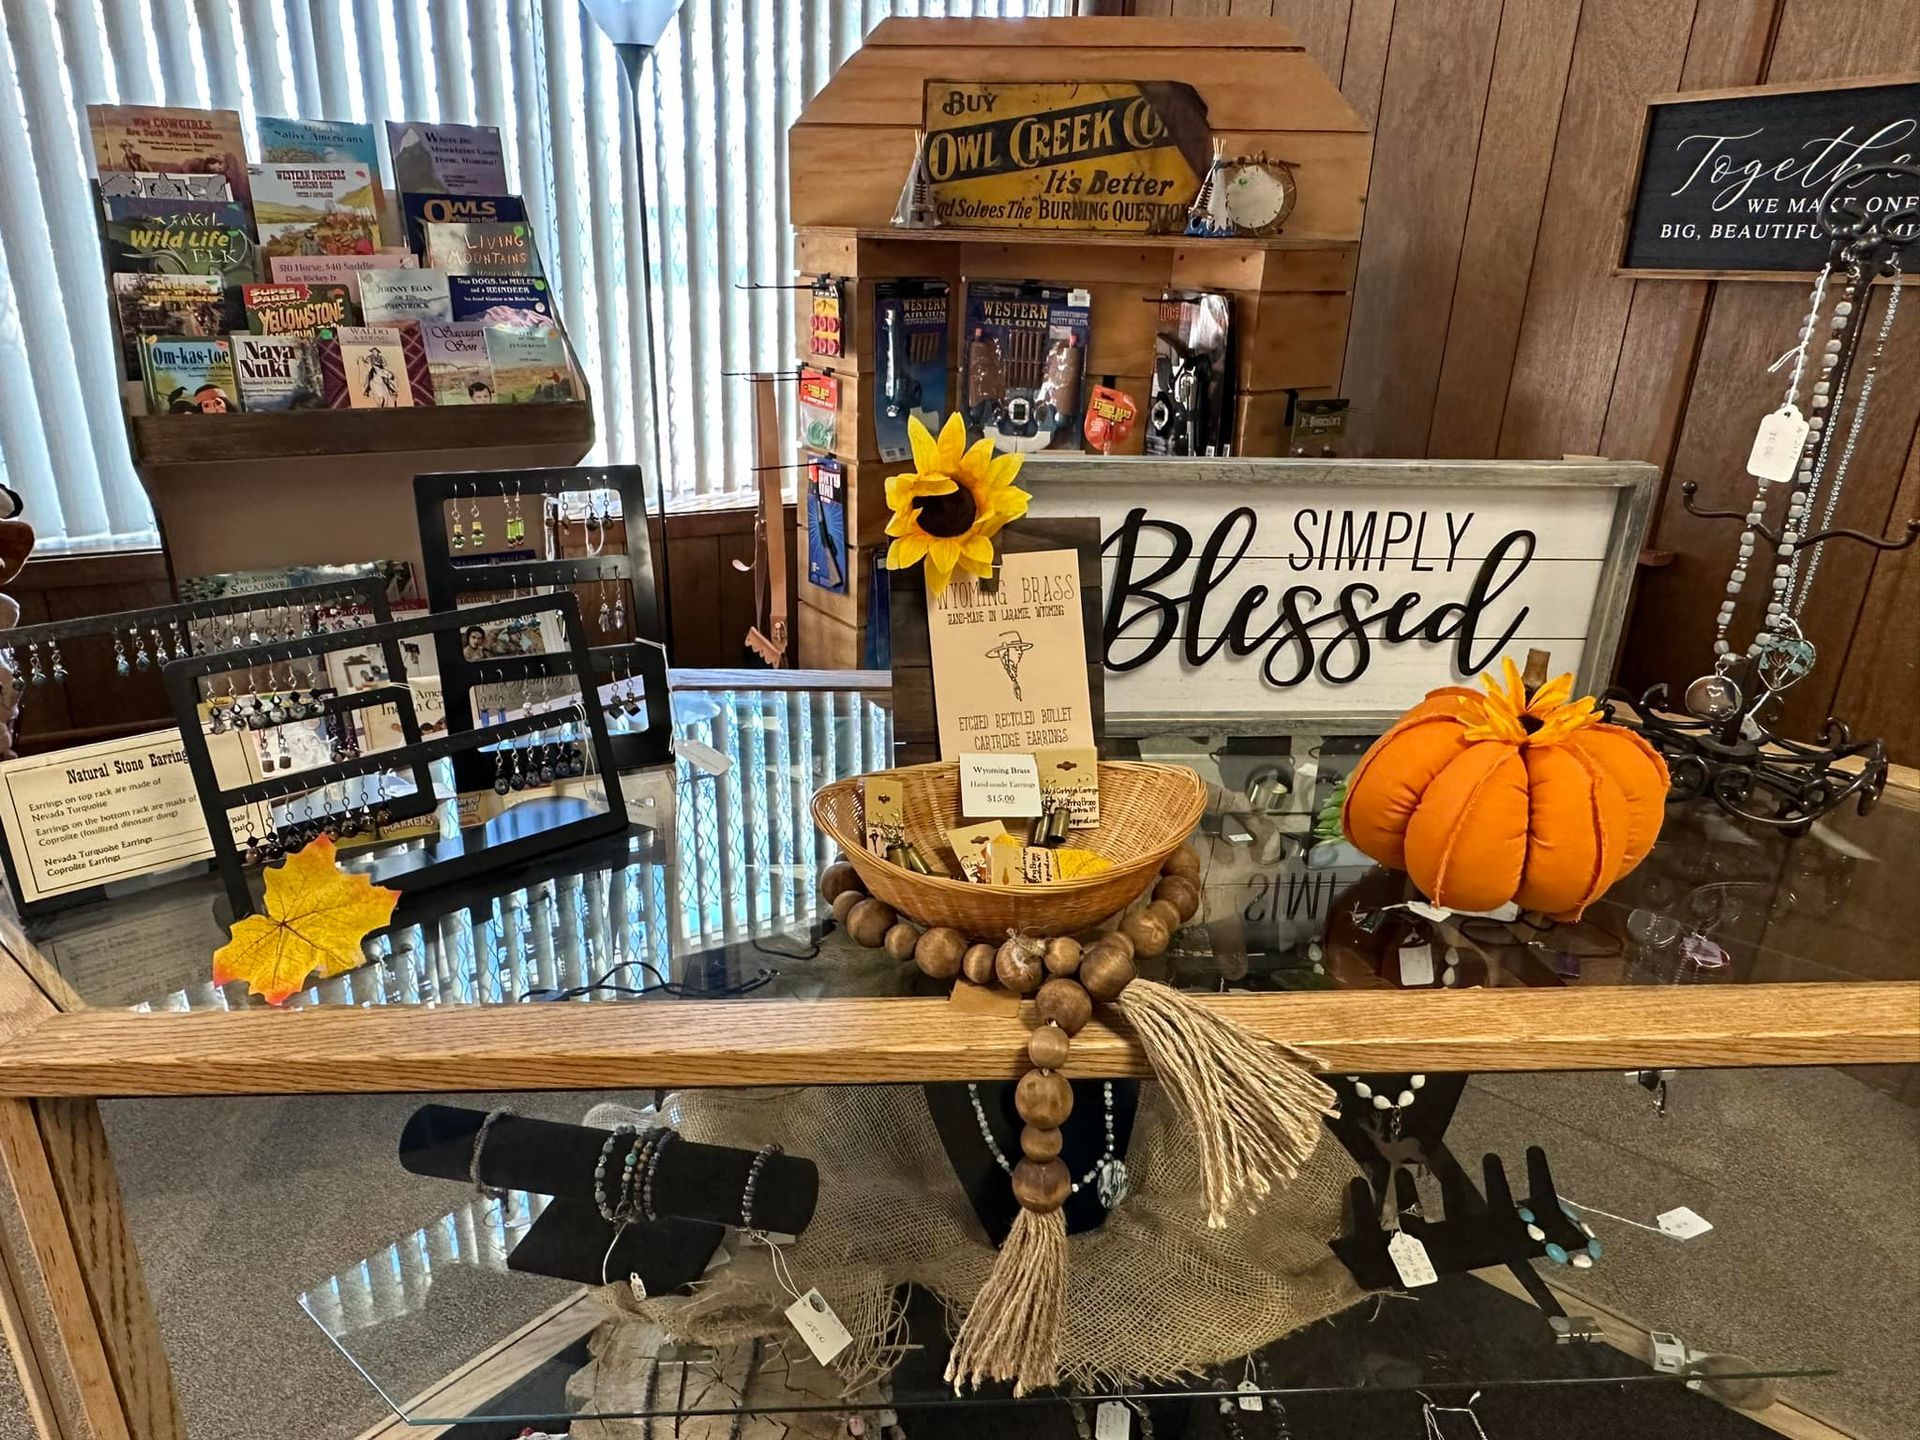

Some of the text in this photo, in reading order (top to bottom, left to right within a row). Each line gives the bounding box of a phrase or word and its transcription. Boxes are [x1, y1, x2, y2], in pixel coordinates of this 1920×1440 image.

[942, 91, 997, 116] BUY
[154, 118, 212, 130] COWGIRLS
[928, 96, 1168, 181] OWL CREEK CO
[275, 169, 310, 181] WESTERN
[1671, 119, 1916, 211] Togethe
[1044, 169, 1174, 196] It's Better
[423, 199, 497, 223] OWLS
[956, 198, 1005, 218] Solves
[1007, 198, 1032, 219] The
[1039, 199, 1108, 221] BURNING
[1747, 198, 1778, 214] WE
[130, 230, 230, 248] Wild Life
[464, 234, 524, 250] LIVING
[1660, 224, 1701, 240] BIG,
[1710, 224, 1836, 240] BEAUTIFU
[448, 249, 527, 265] MOUNTAINS
[486, 286, 530, 294] REINDEER
[903, 299, 946, 311] WESTERN
[983, 301, 1048, 319] WESTERN
[258, 298, 345, 336] YELLOWSTONE
[984, 318, 1048, 329] AIR GUN
[243, 341, 296, 364] Naya
[239, 359, 291, 378] Nuki
[1288, 509, 1474, 572] SIMPLY
[1021, 573, 1076, 604] BRASS
[1100, 506, 1536, 687] Blessed
[958, 706, 1072, 732] ETCHED RECYCLED BULLET
[974, 728, 1069, 751] CARTRIDGE EARRINGS
[66, 749, 190, 785] Natural Stone Earring
[973, 765, 1031, 776] Wyoming Brass
[29, 777, 161, 812] Earrings on top rack are made of
[987, 794, 1016, 805] $15.00
[31, 800, 108, 822] Nevada Turquoise
[36, 824, 69, 836] Earrings
[85, 817, 98, 826] the
[100, 809, 131, 822] bottom
[132, 805, 149, 815] rack
[151, 803, 164, 811] are
[166, 799, 186, 809] made
[38, 832, 79, 847] Coprolite
[121, 815, 154, 829] dinosaur
[43, 836, 153, 867] Nevada Turquoise Earrings
[46, 854, 121, 877] Coprolite Earrings
